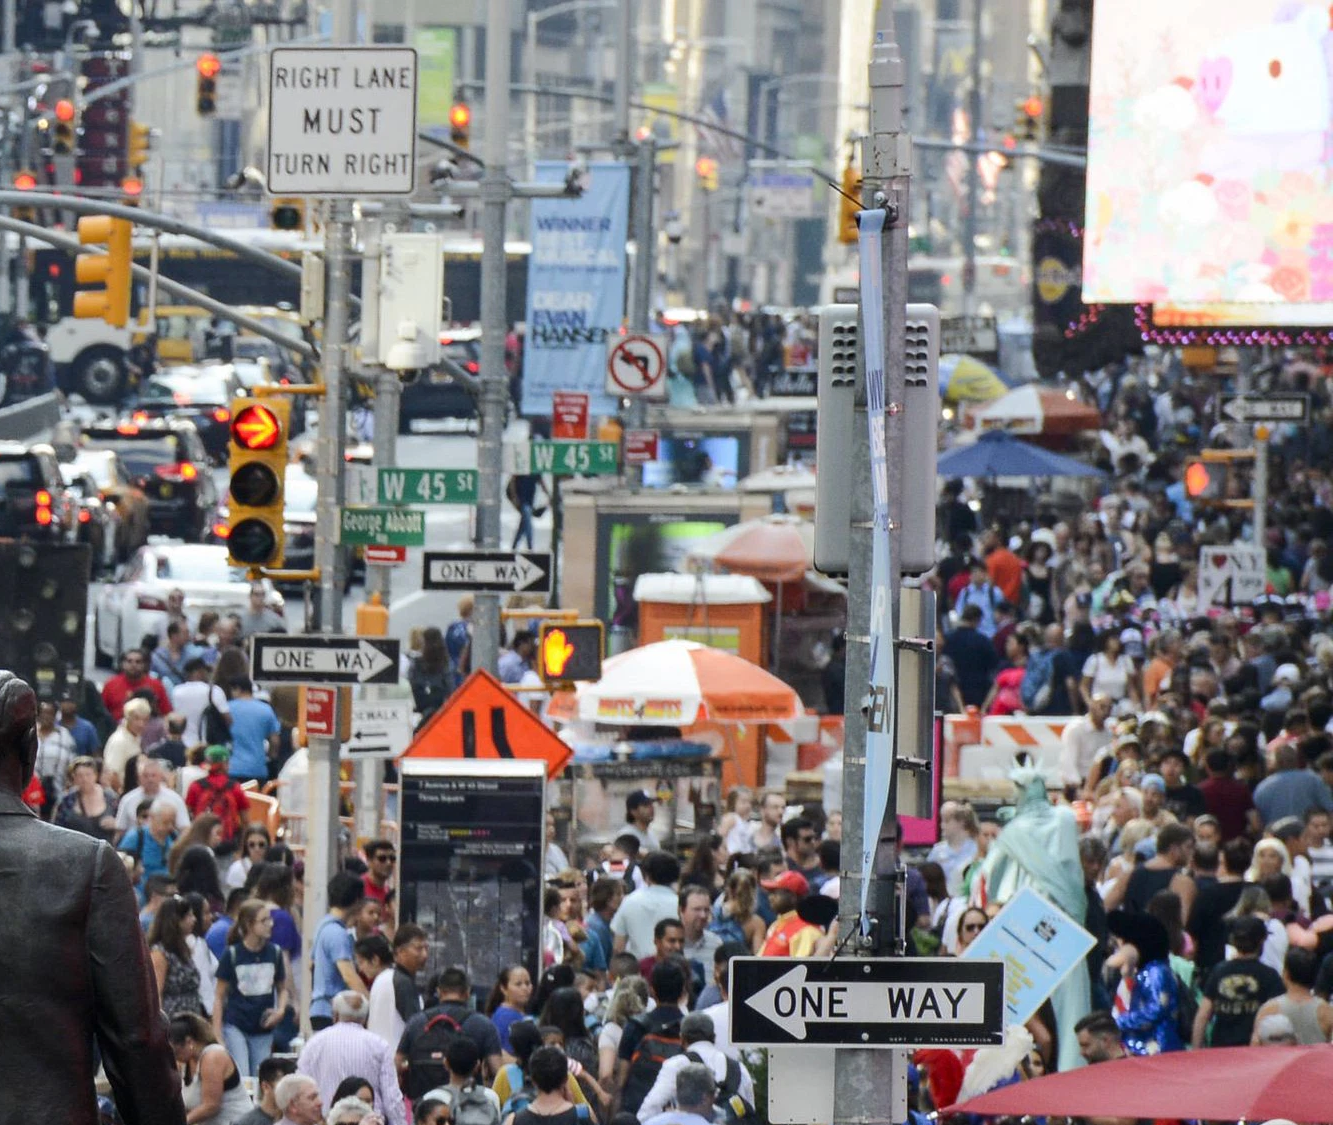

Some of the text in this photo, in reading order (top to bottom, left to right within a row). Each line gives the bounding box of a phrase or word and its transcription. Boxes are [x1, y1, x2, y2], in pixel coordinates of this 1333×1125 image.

[275, 66, 411, 89] RIGHT LANE
[303, 107, 382, 135] MUST
[273, 152, 410, 175] TURN RIGHT
[536, 216, 611, 233] WINNER
[533, 310, 587, 327] EVAN
[534, 444, 555, 468] W
[563, 444, 590, 469] 45
[599, 443, 614, 461] St
[382, 471, 474, 501] W 45 St
[343, 511, 422, 535] George Abbott
[440, 563, 533, 581] ONE WAY
[273, 650, 377, 670] ONE WAY
[773, 986, 969, 1019] ONE WAY
